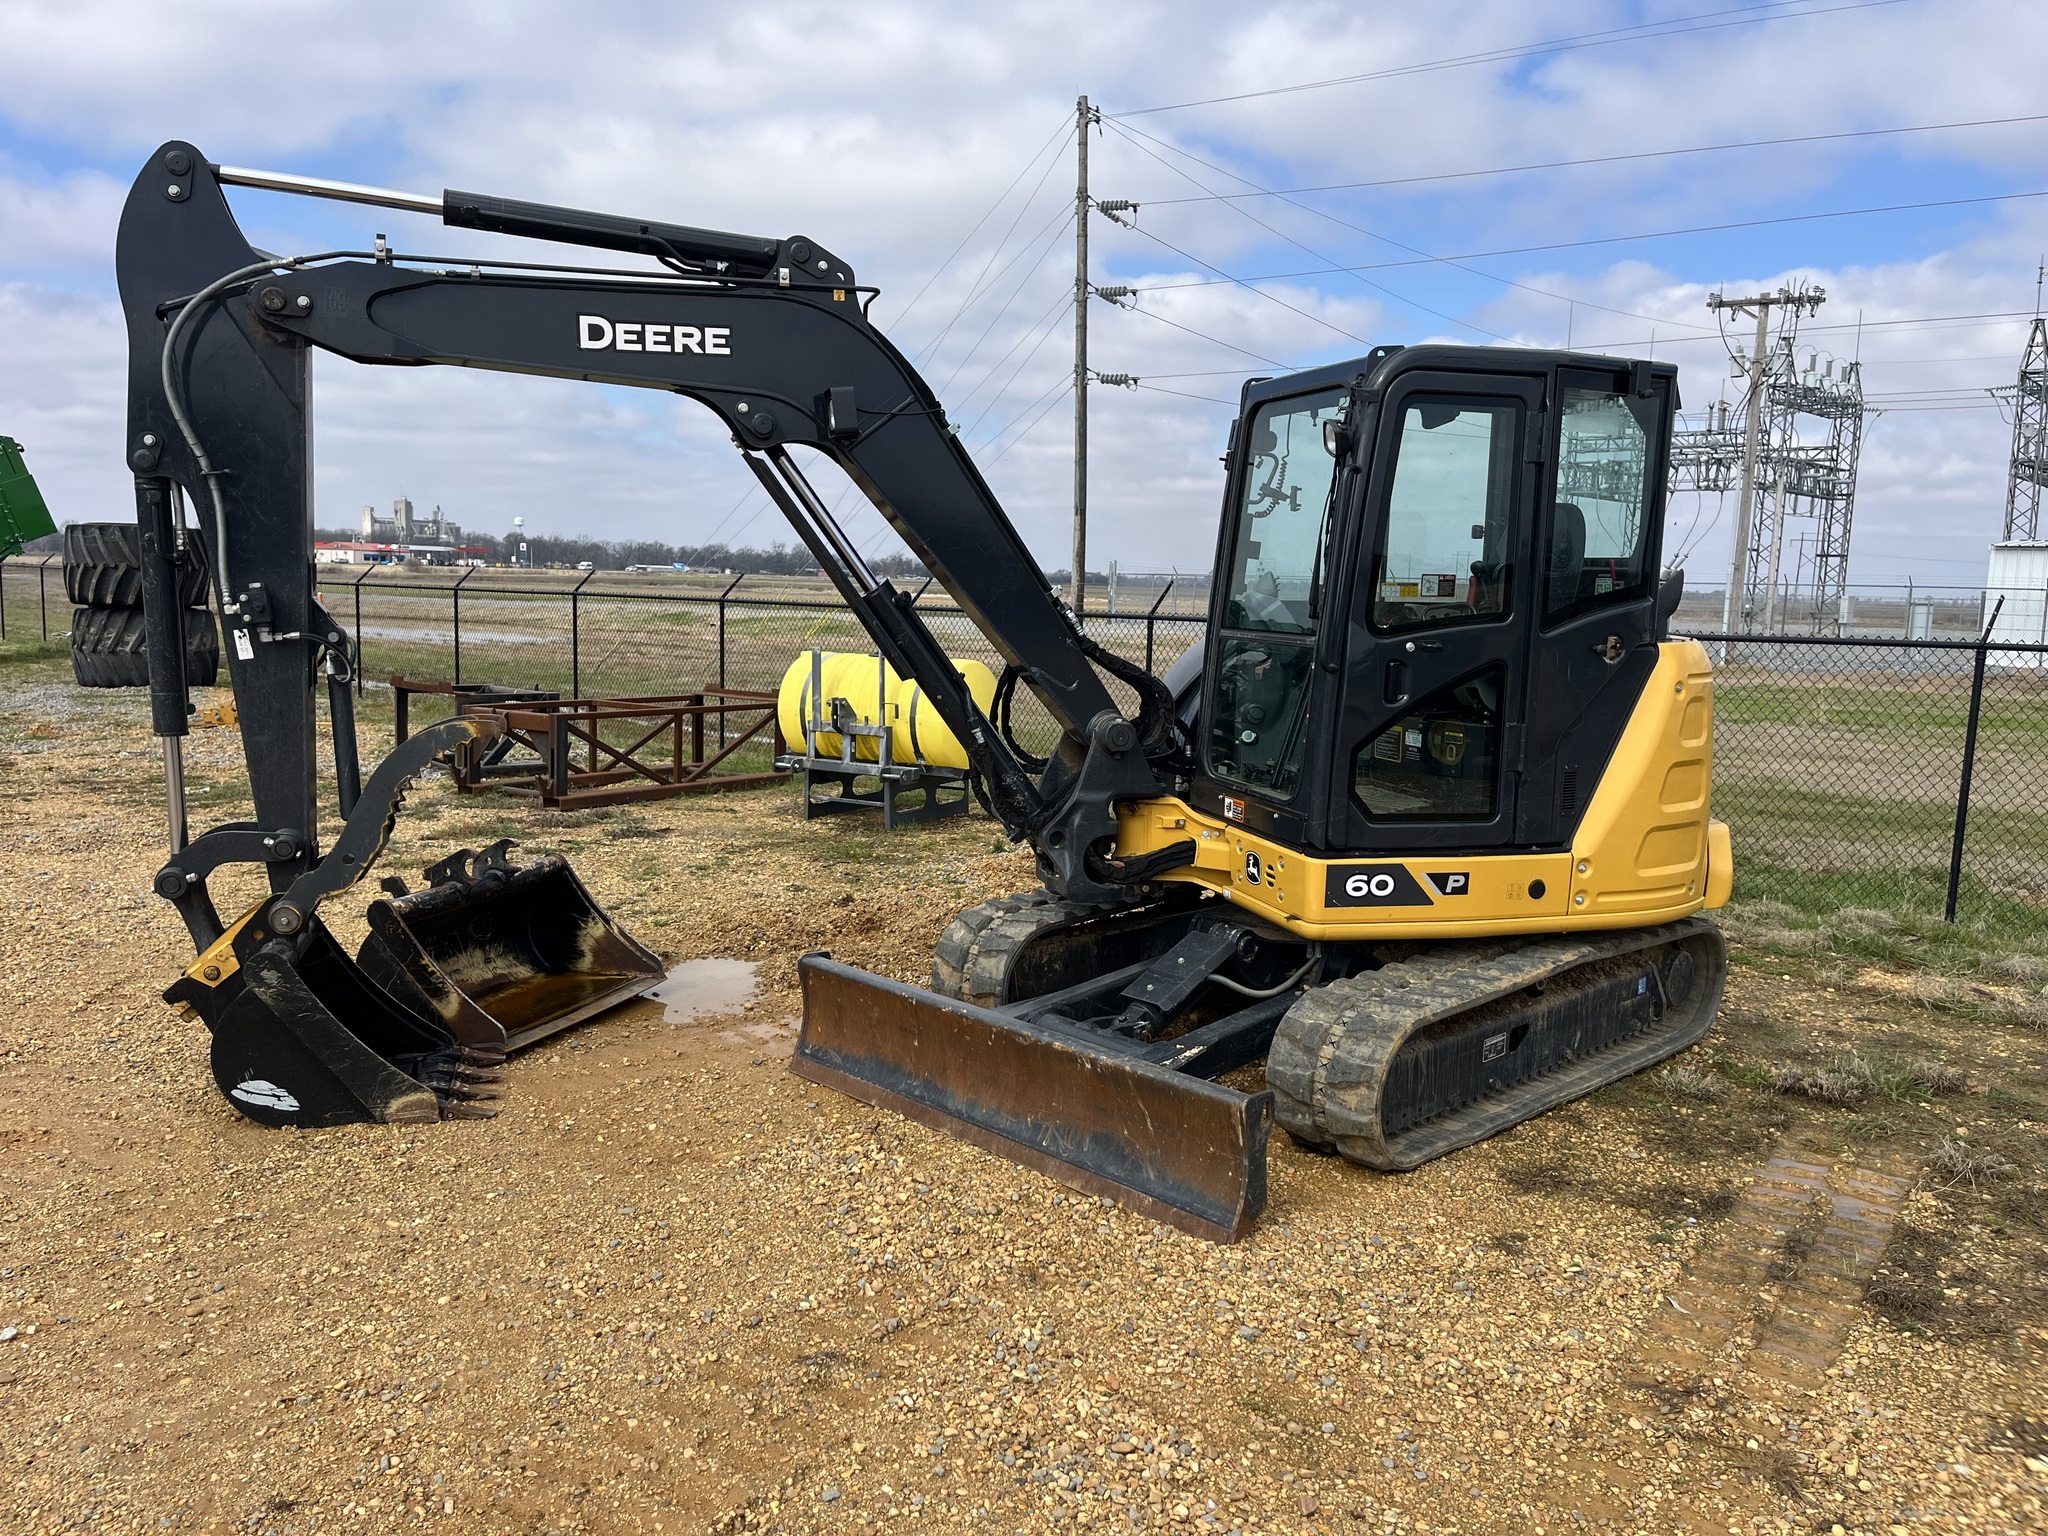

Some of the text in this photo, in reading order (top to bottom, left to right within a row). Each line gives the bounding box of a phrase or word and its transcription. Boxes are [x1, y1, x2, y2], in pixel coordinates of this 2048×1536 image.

[579, 315, 731, 355] DEERE
[1345, 874, 1466, 897] 60 P
